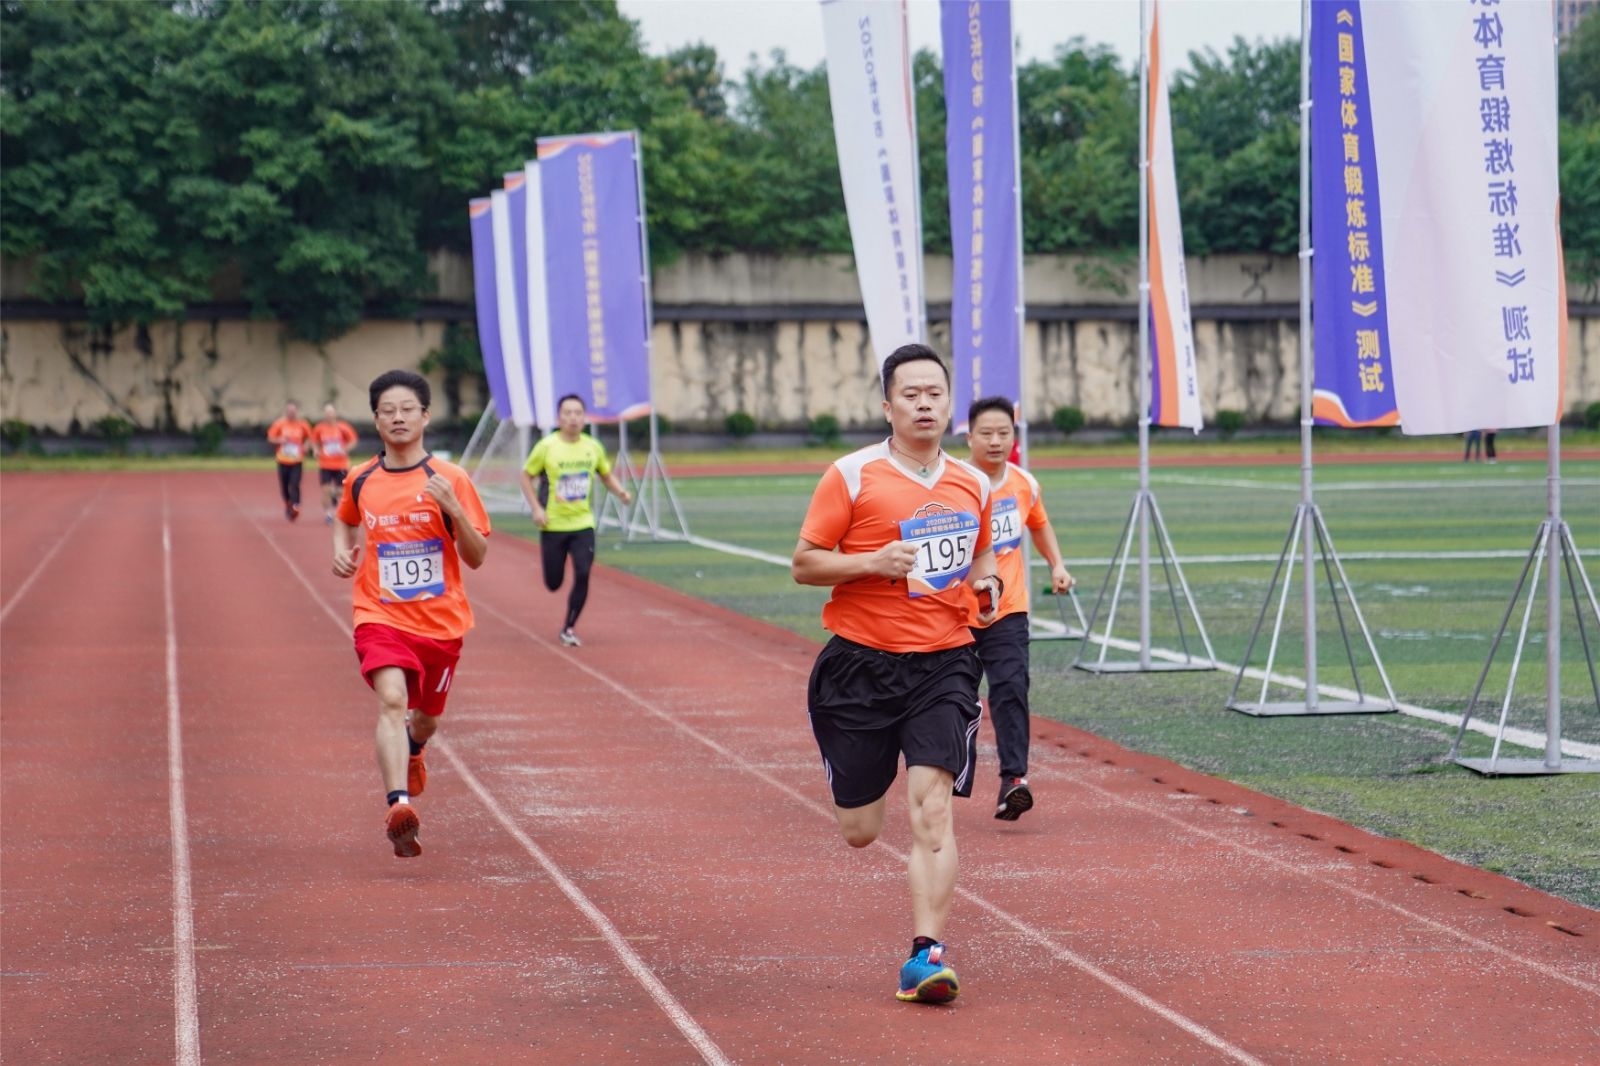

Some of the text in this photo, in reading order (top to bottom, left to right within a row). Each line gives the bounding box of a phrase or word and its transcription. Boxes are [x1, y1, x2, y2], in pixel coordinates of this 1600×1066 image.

[1336, 9, 1384, 392] 《国家体育锻炼标准》测试
[391, 558, 433, 586] 193
[921, 535, 967, 573] 195
